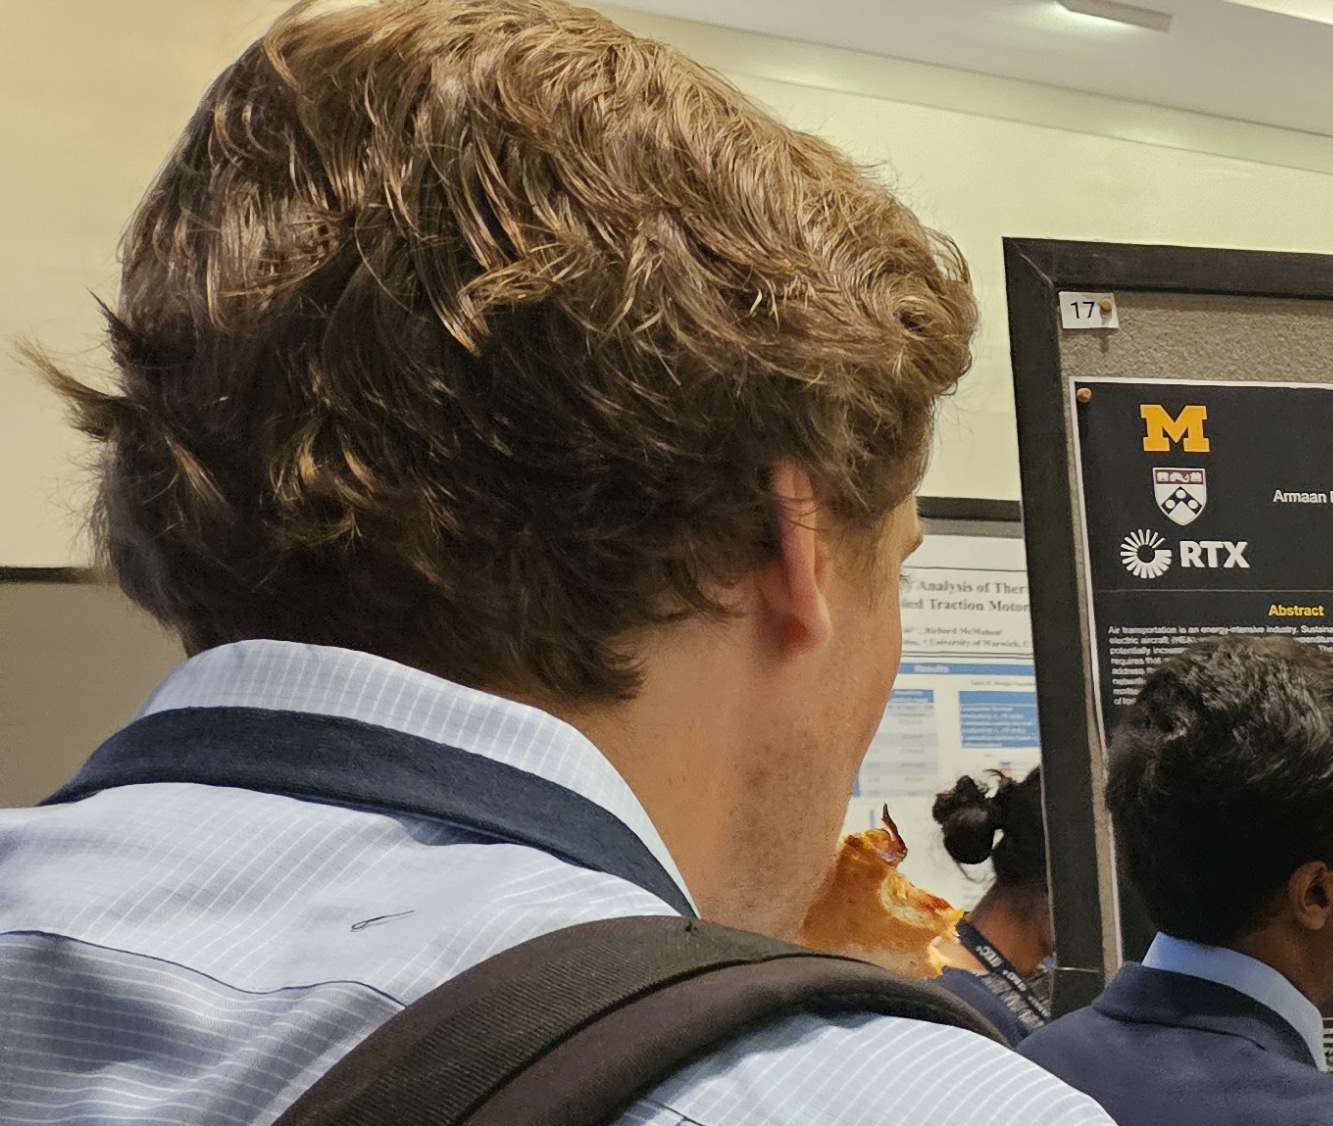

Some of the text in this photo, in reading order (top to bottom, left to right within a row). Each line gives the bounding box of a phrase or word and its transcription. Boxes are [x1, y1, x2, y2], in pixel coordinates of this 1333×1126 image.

[1070, 301, 1095, 319] 17
[1139, 404, 1210, 453] M
[1272, 489, 1326, 503] Armaan
[1179, 540, 1249, 567] RTX
[1268, 604, 1324, 616] Abstract
